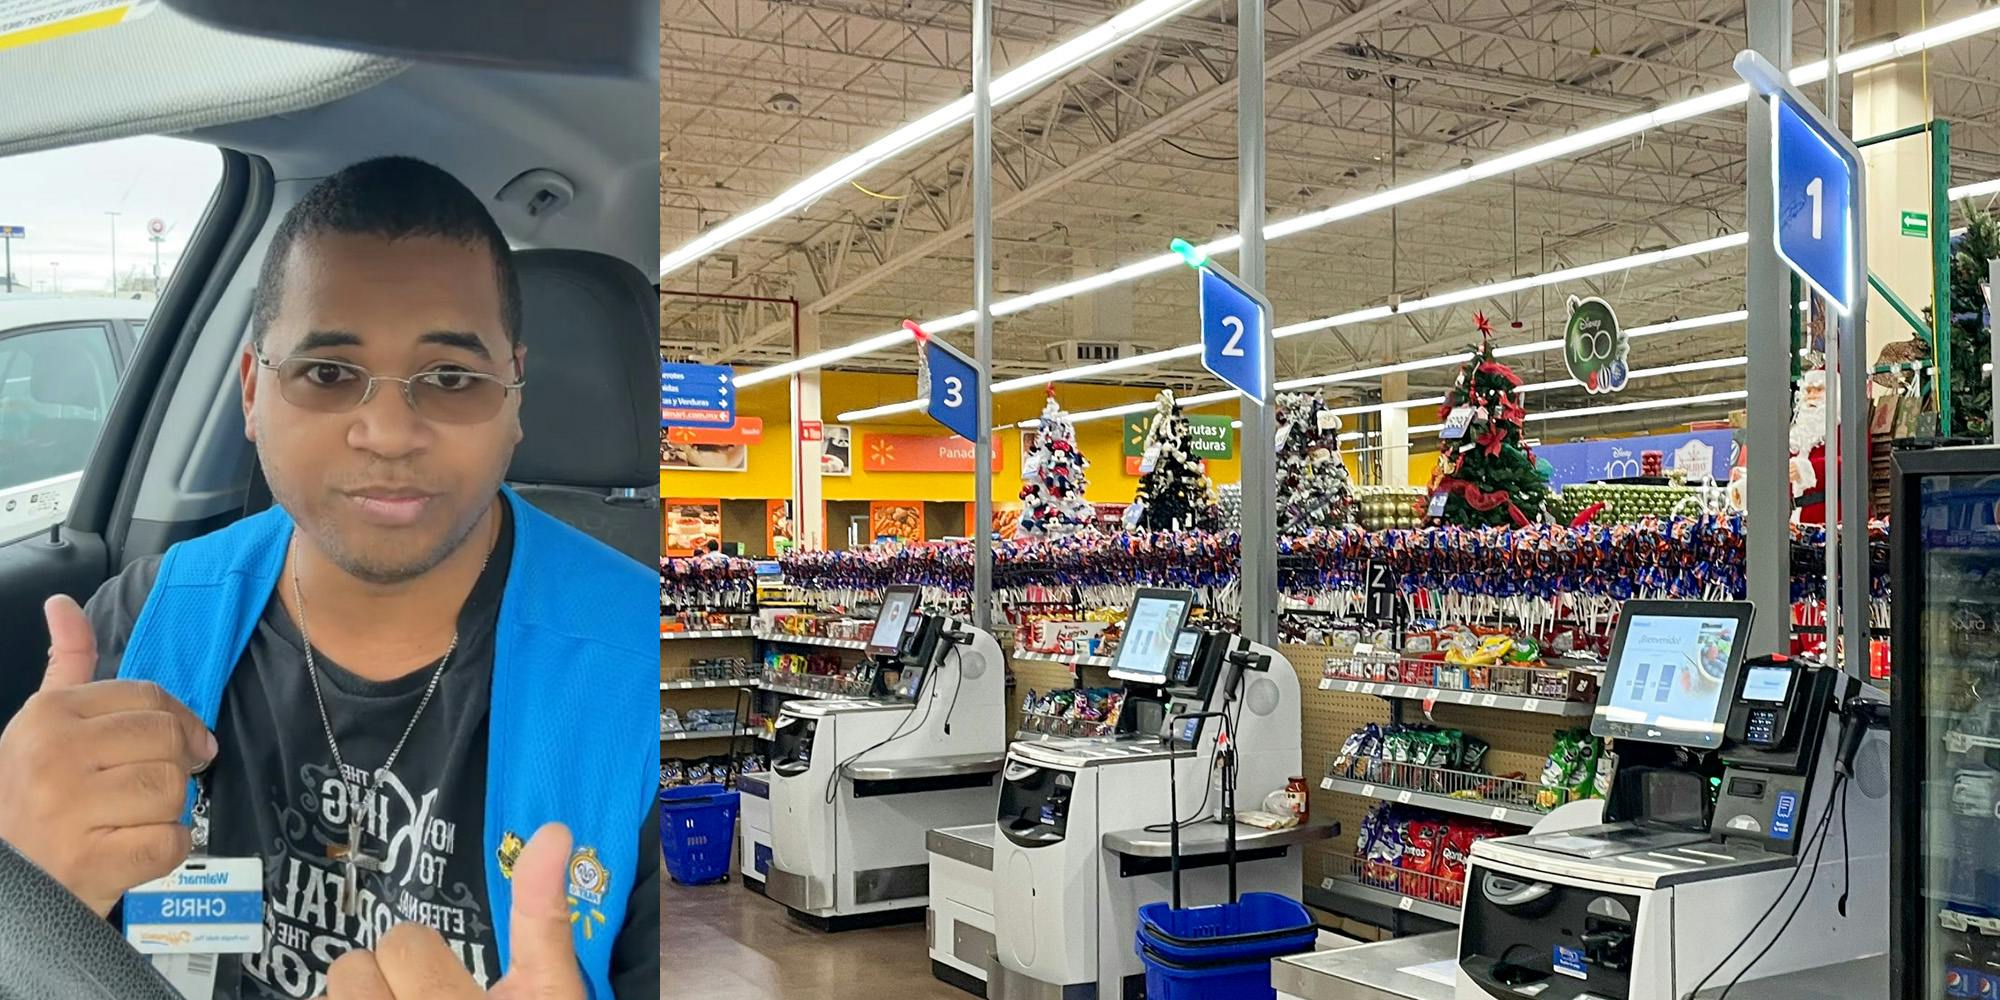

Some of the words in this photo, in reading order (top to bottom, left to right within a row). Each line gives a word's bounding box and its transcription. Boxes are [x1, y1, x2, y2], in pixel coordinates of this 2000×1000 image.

[1806, 177, 1823, 240] 1
[1579, 316, 1602, 331] Disney
[1221, 315, 1245, 357] 2
[1570, 330, 1612, 363] 100
[943, 376, 963, 408] 3
[677, 398, 709, 407] Verduras
[1188, 424, 1217, 436] rutas
[1218, 426, 1226, 439] y
[1189, 437, 1226, 451] rduras
[939, 446, 996, 459] Panada
[1611, 446, 1633, 459] Disney
[1603, 459, 1640, 479] 100
